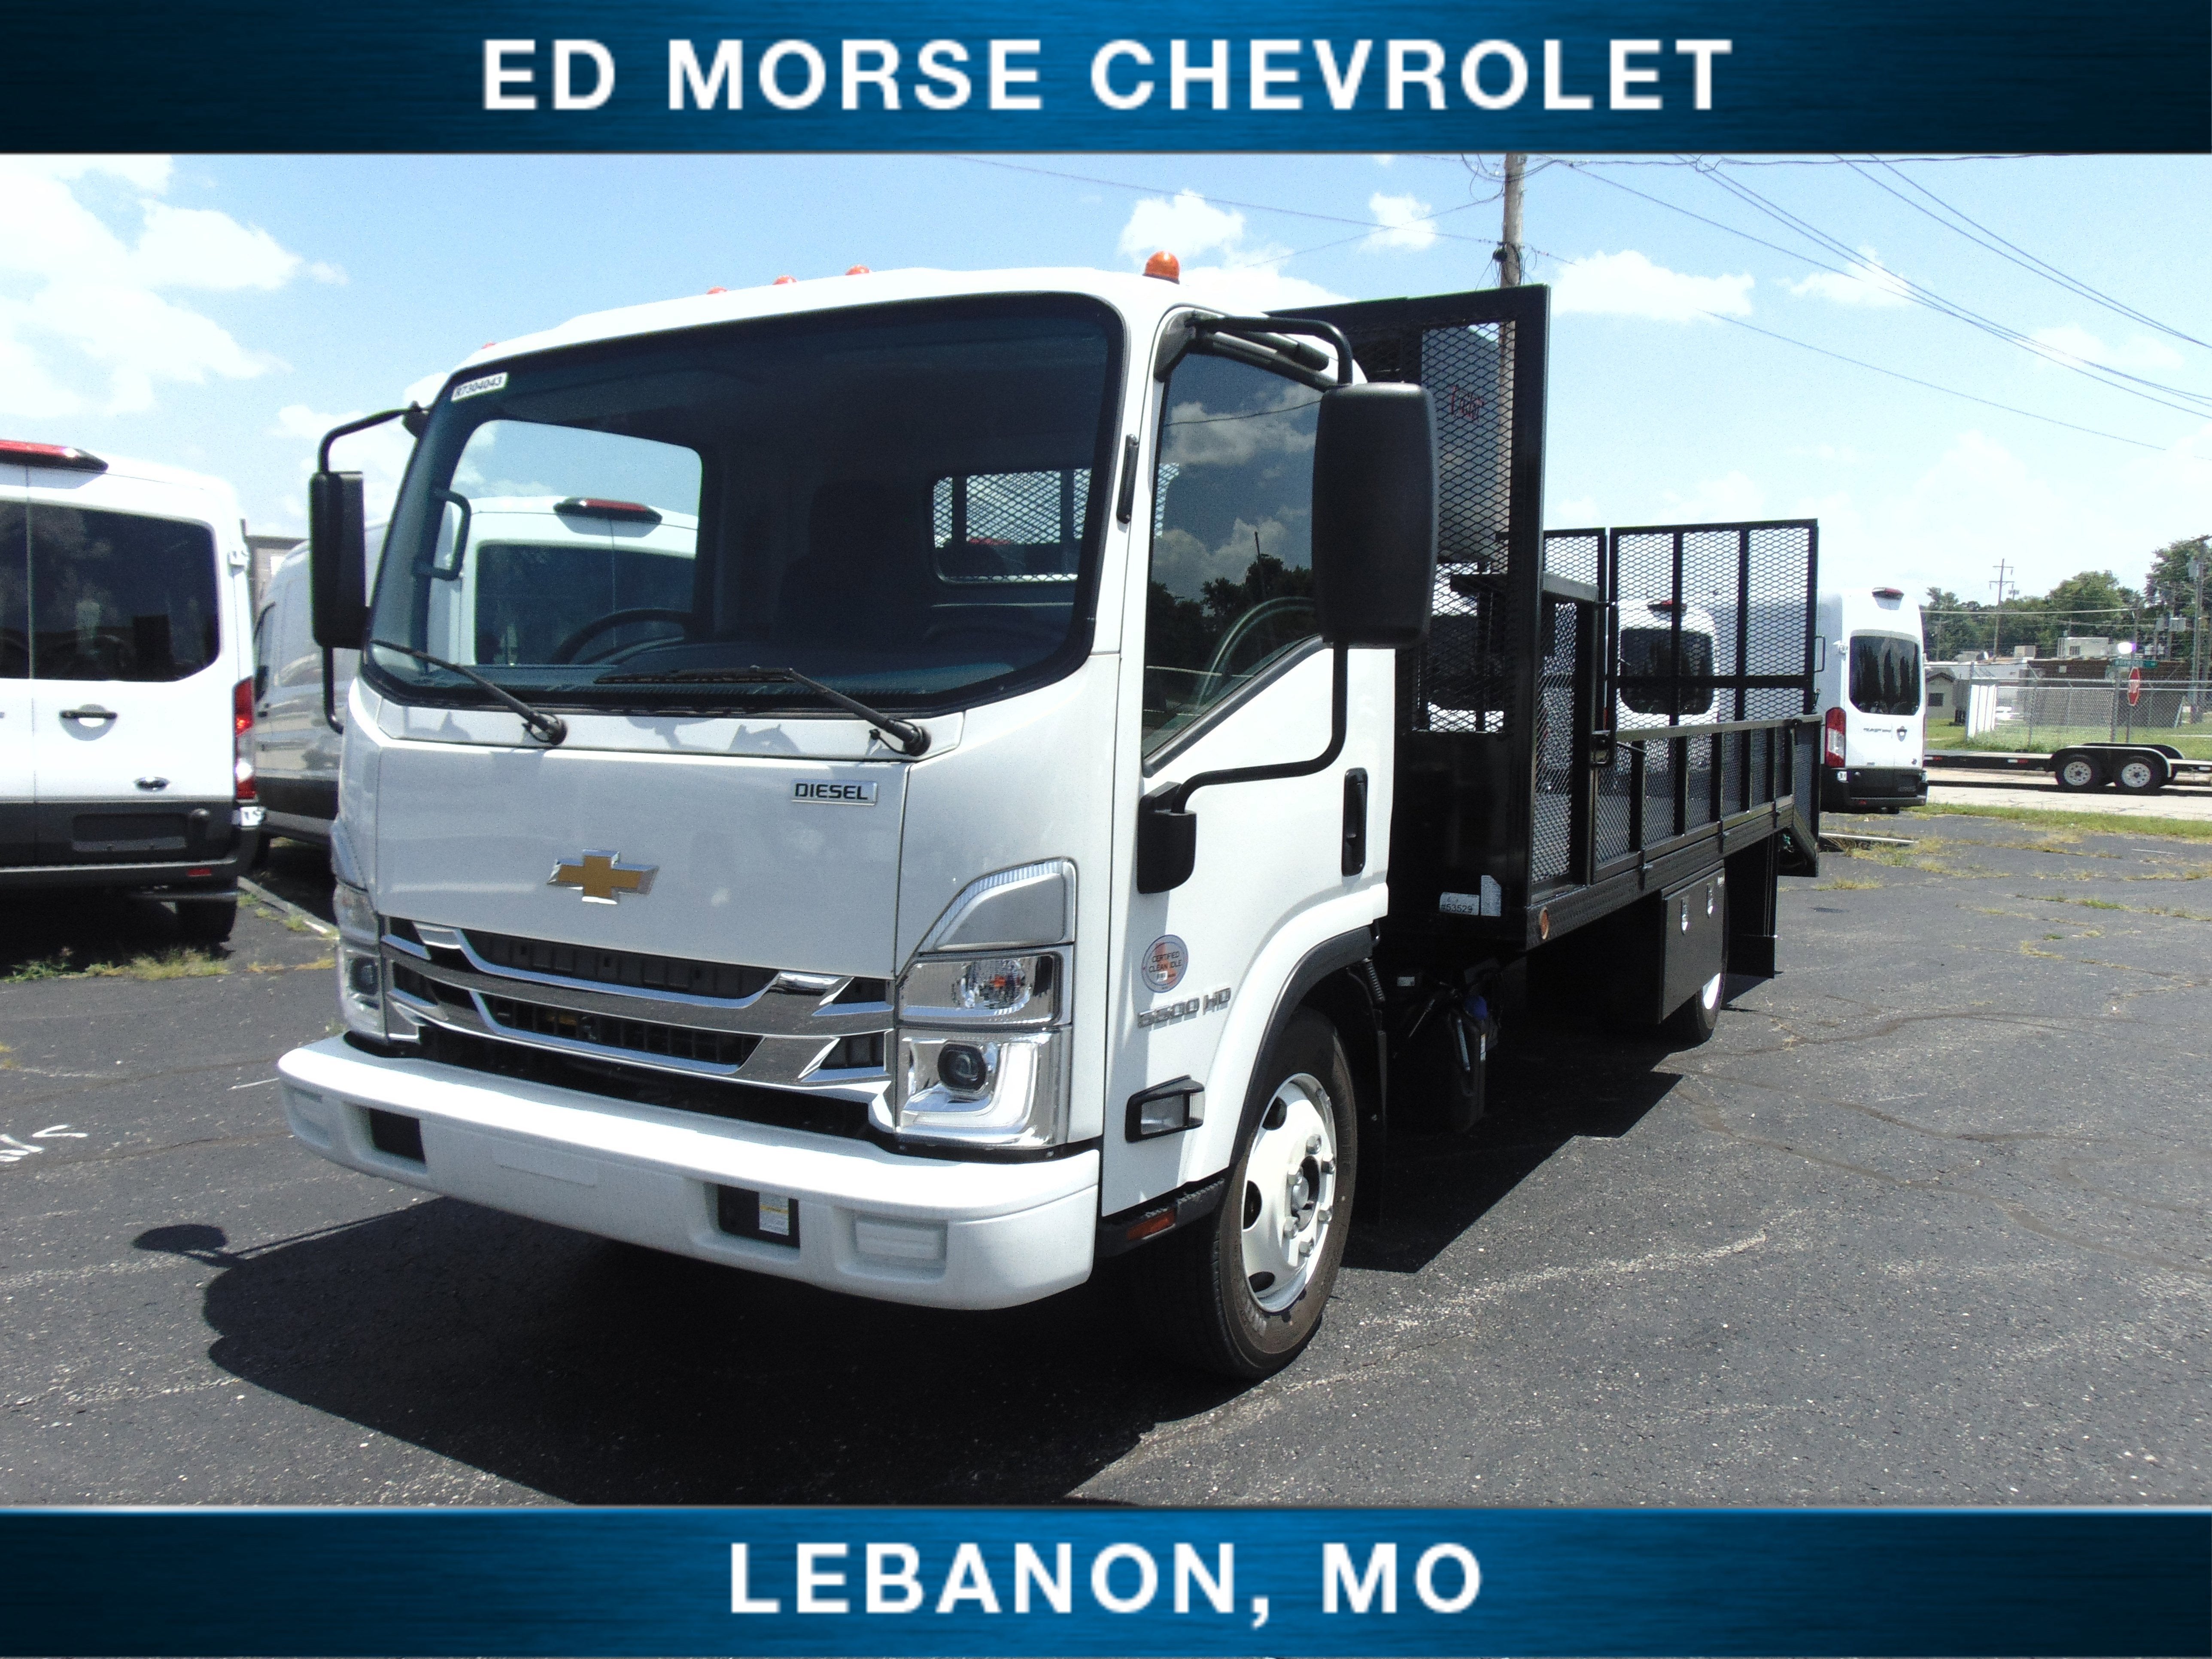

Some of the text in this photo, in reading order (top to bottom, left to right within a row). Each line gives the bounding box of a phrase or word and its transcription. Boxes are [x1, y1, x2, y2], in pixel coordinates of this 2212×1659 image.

[795, 783, 868, 799] DIESEL
[1441, 903, 1473, 914] #53529
[1152, 951, 1180, 962] CERTIFIED
[1149, 963, 1168, 973] CLEAN
[1203, 988, 1231, 1015] HD
